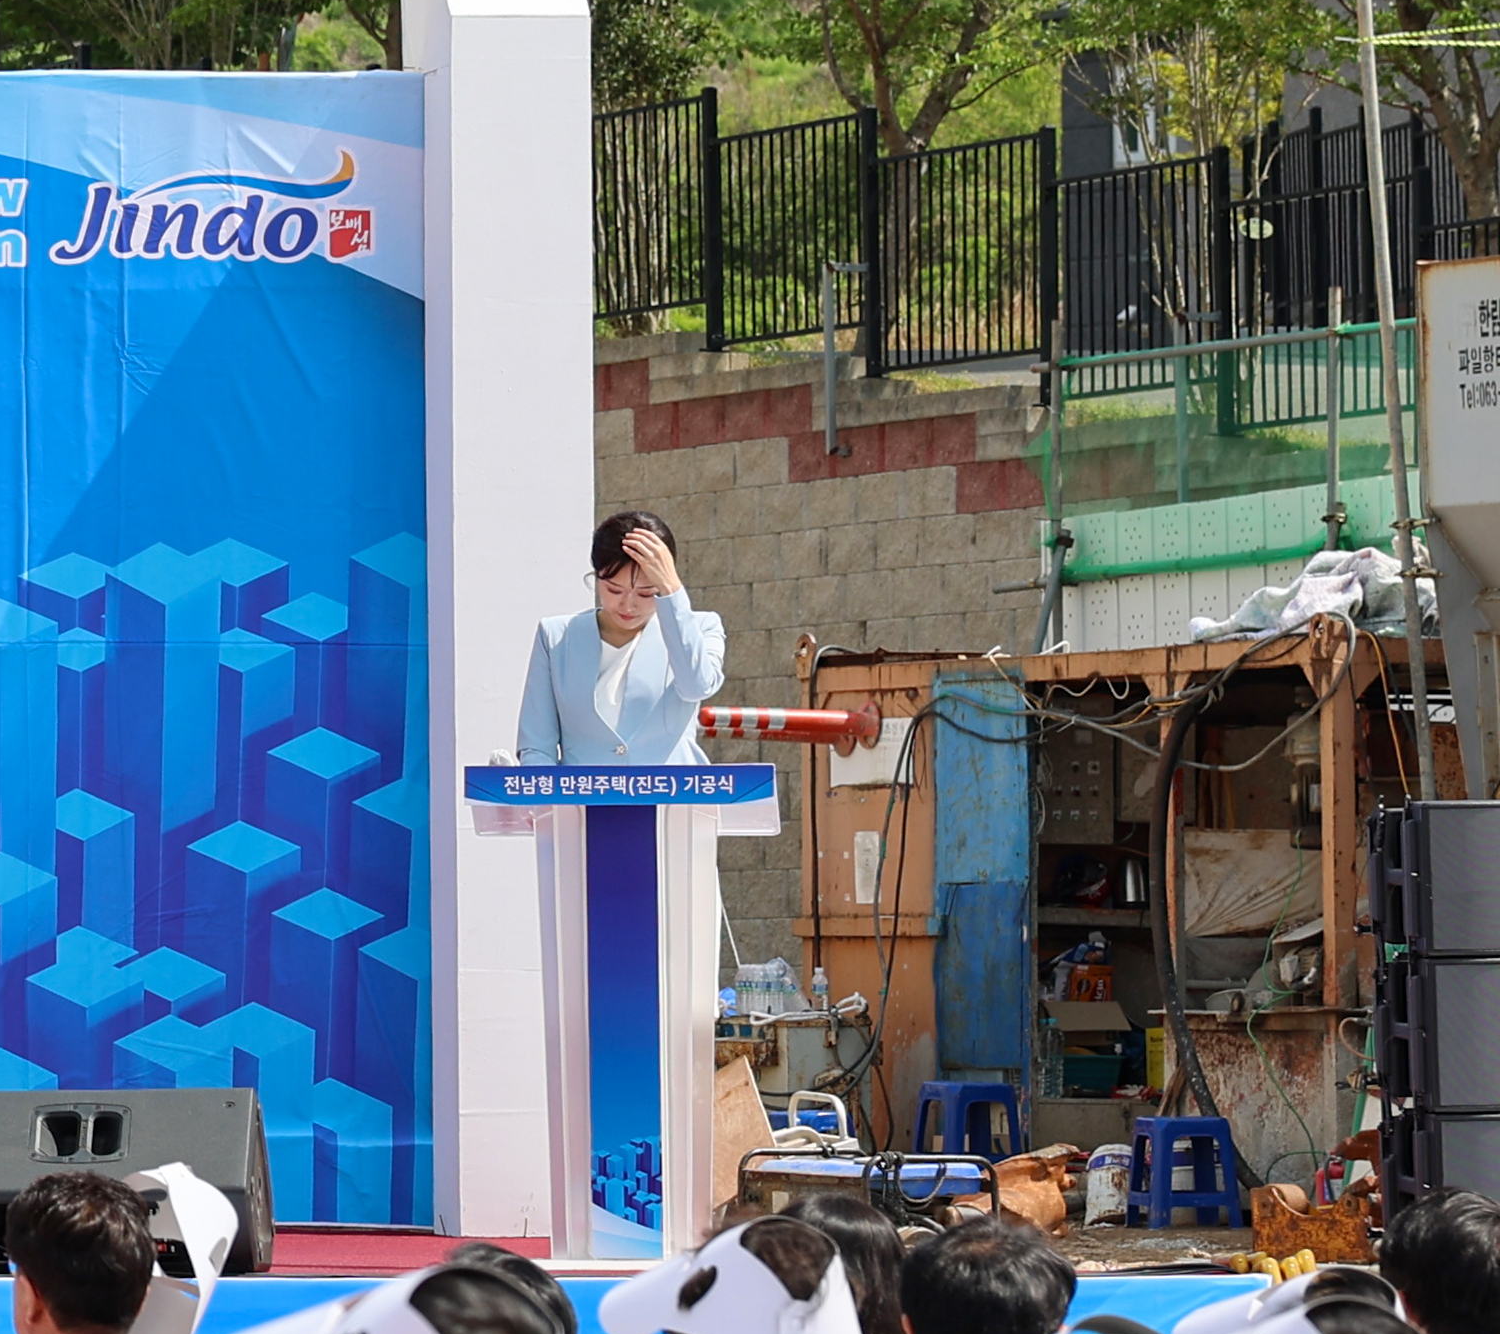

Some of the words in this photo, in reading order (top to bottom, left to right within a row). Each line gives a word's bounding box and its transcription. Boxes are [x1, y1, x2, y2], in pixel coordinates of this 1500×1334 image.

[50, 182, 324, 265] Jindo
[504, 775, 554, 795] 전남형
[560, 775, 677, 797] 만원주택(진도)
[684, 774, 734, 795] 기공식
